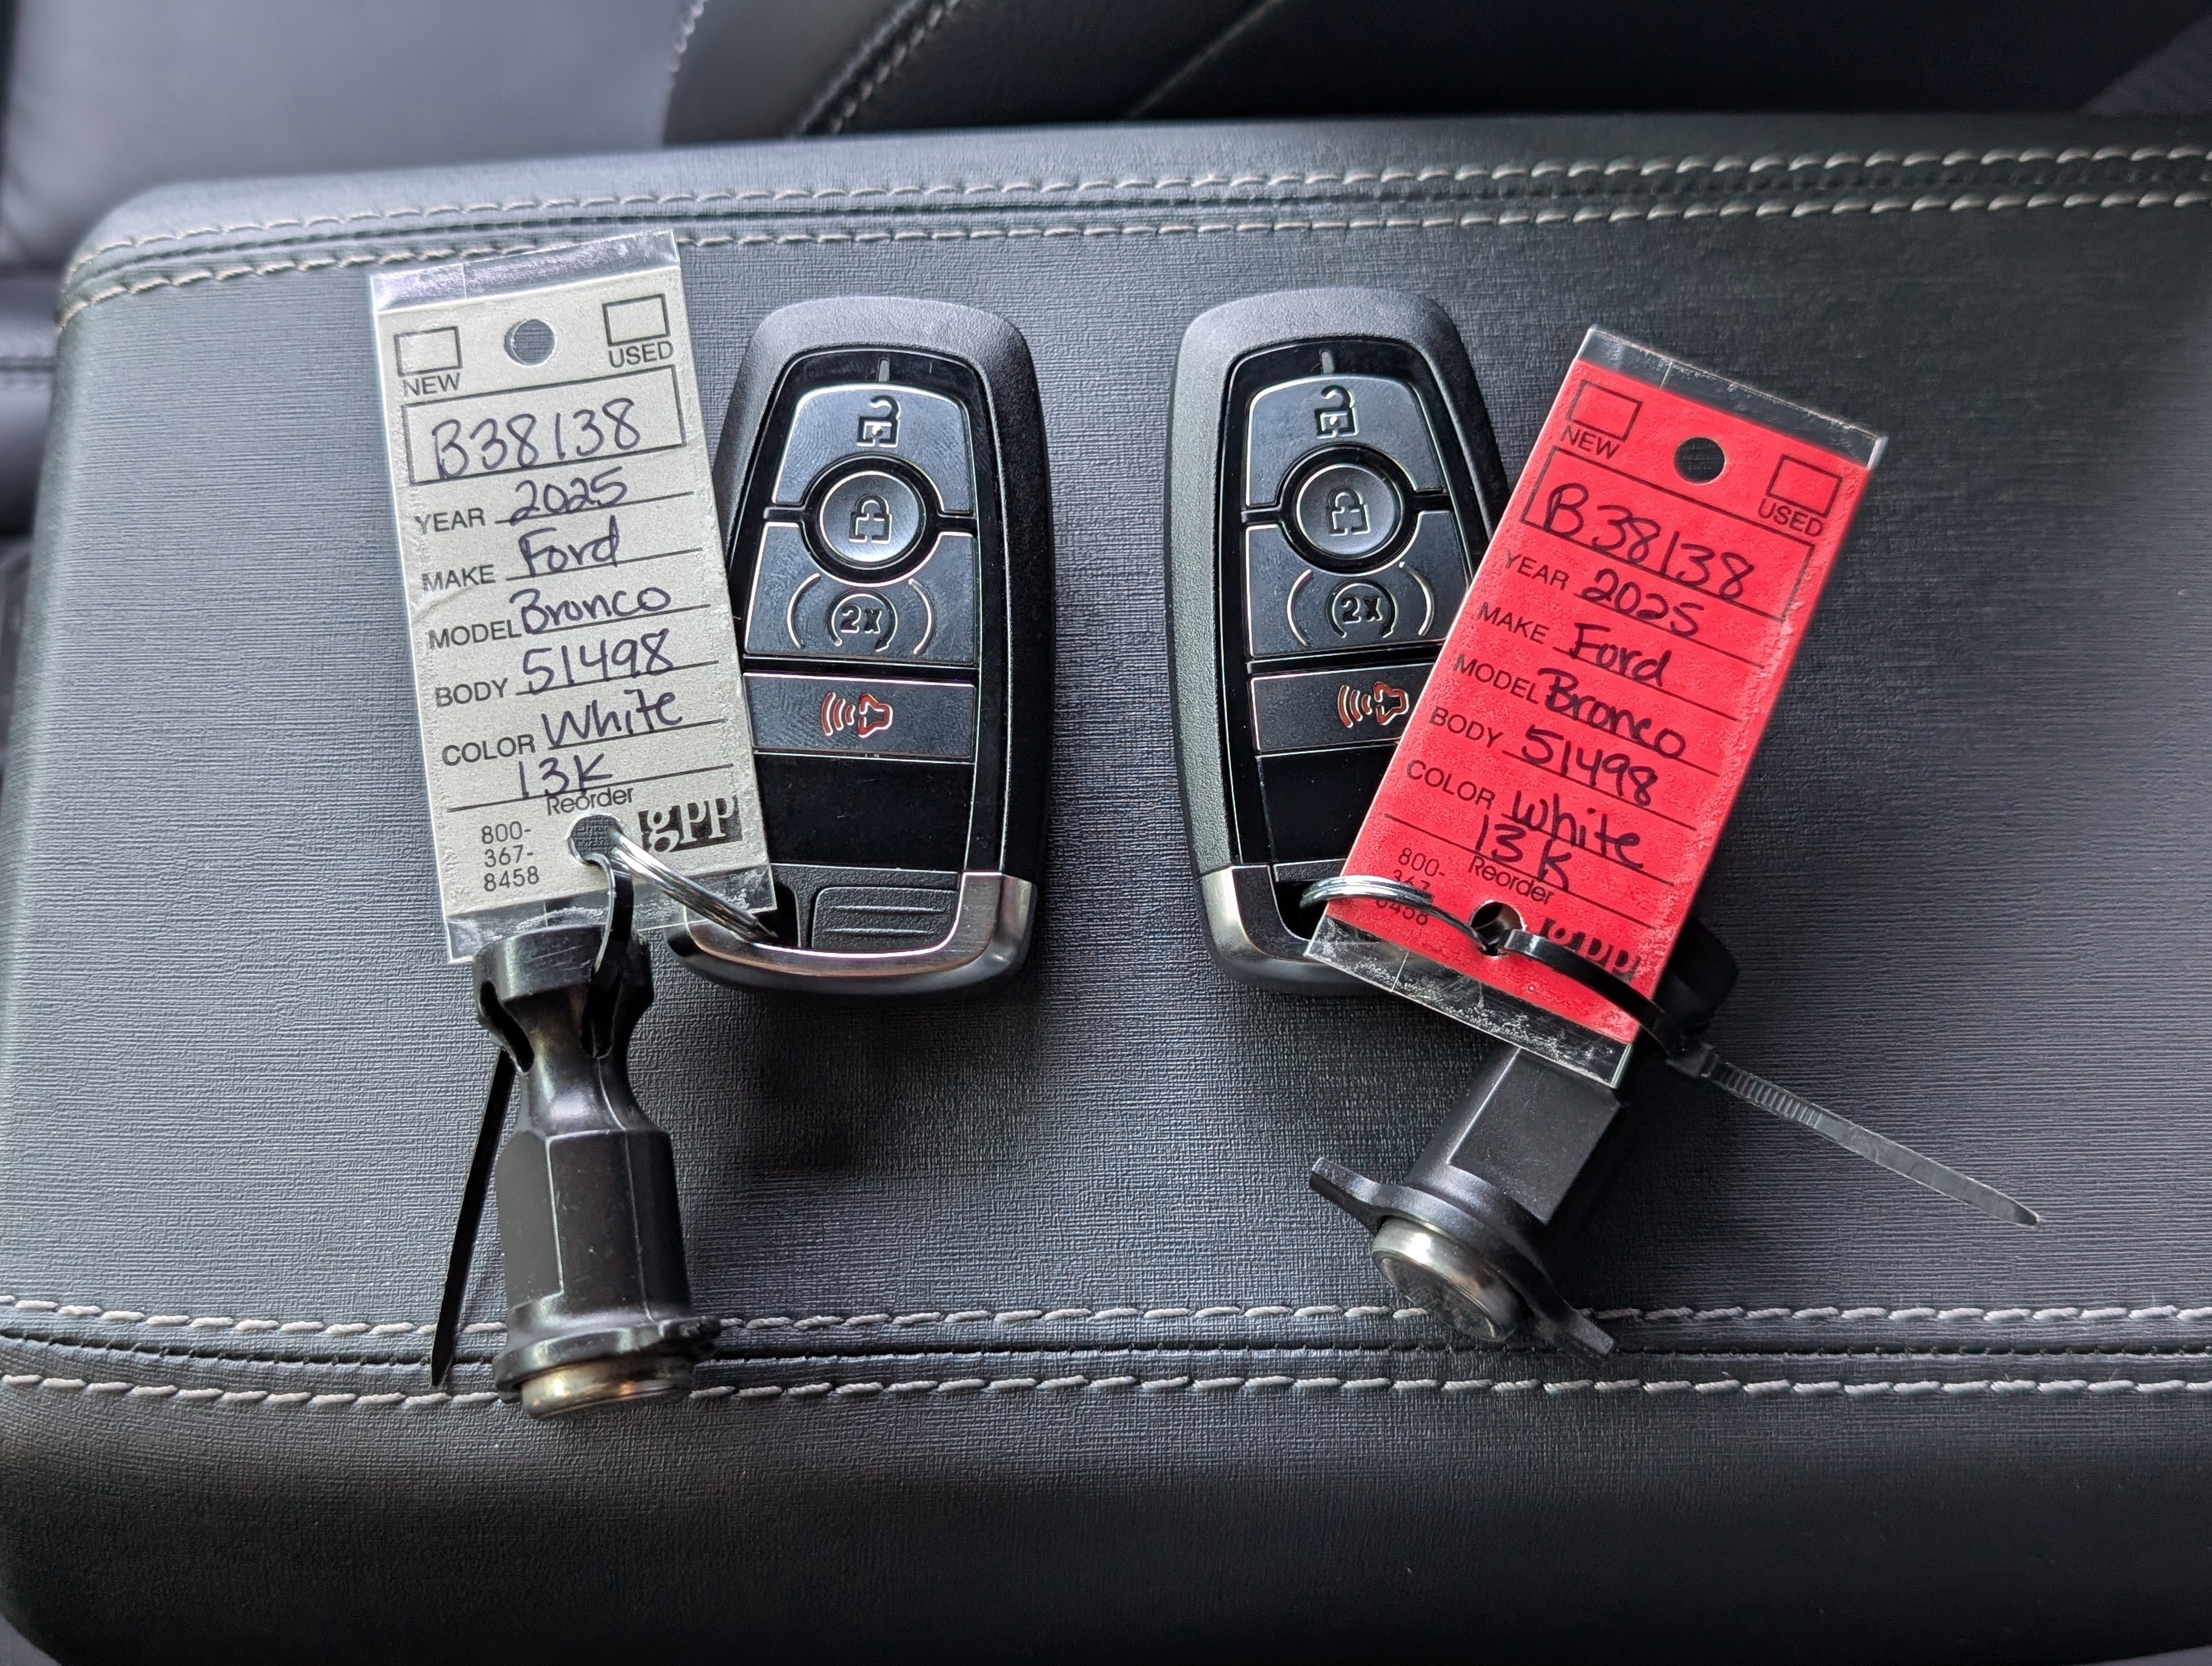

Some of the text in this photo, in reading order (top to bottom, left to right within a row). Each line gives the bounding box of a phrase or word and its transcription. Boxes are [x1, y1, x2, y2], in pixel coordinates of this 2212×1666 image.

[608, 339, 674, 369] USED
[402, 373, 461, 398] NEW
[432, 398, 641, 479] B38138
[1560, 427, 1622, 459] NEW
[510, 467, 628, 526] 2025
[1757, 498, 1824, 539] USED
[414, 507, 486, 535] YEAR
[1545, 483, 1755, 598] B38138
[518, 515, 620, 578] Ford
[422, 564, 496, 592] MAKE
[1504, 550, 1570, 590] YEAR
[510, 587, 671, 634] Bronco
[1476, 601, 1549, 644] MAKE
[1582, 567, 1705, 638] 2025
[428, 619, 523, 649] MODEL
[1569, 621, 1673, 688] Ford
[523, 628, 674, 694] 51498
[1453, 653, 1539, 706] MODEL
[435, 678, 509, 707] BODY
[1538, 667, 1687, 760] Bronco
[541, 688, 683, 748] White
[1429, 705, 1504, 748] BODY
[442, 734, 536, 766] COLOR
[1520, 723, 1659, 808] 51498
[518, 753, 613, 799] 13K
[1406, 759, 1496, 811] COLOR
[546, 787, 633, 816] Reorder
[481, 821, 531, 844] 800-
[641, 796, 742, 853] gpp
[484, 844, 534, 868] 367-
[1398, 847, 1445, 877] 800-
[1476, 813, 1573, 893] 13K
[484, 866, 540, 892] 8458
[1467, 855, 1554, 906] Reorder
